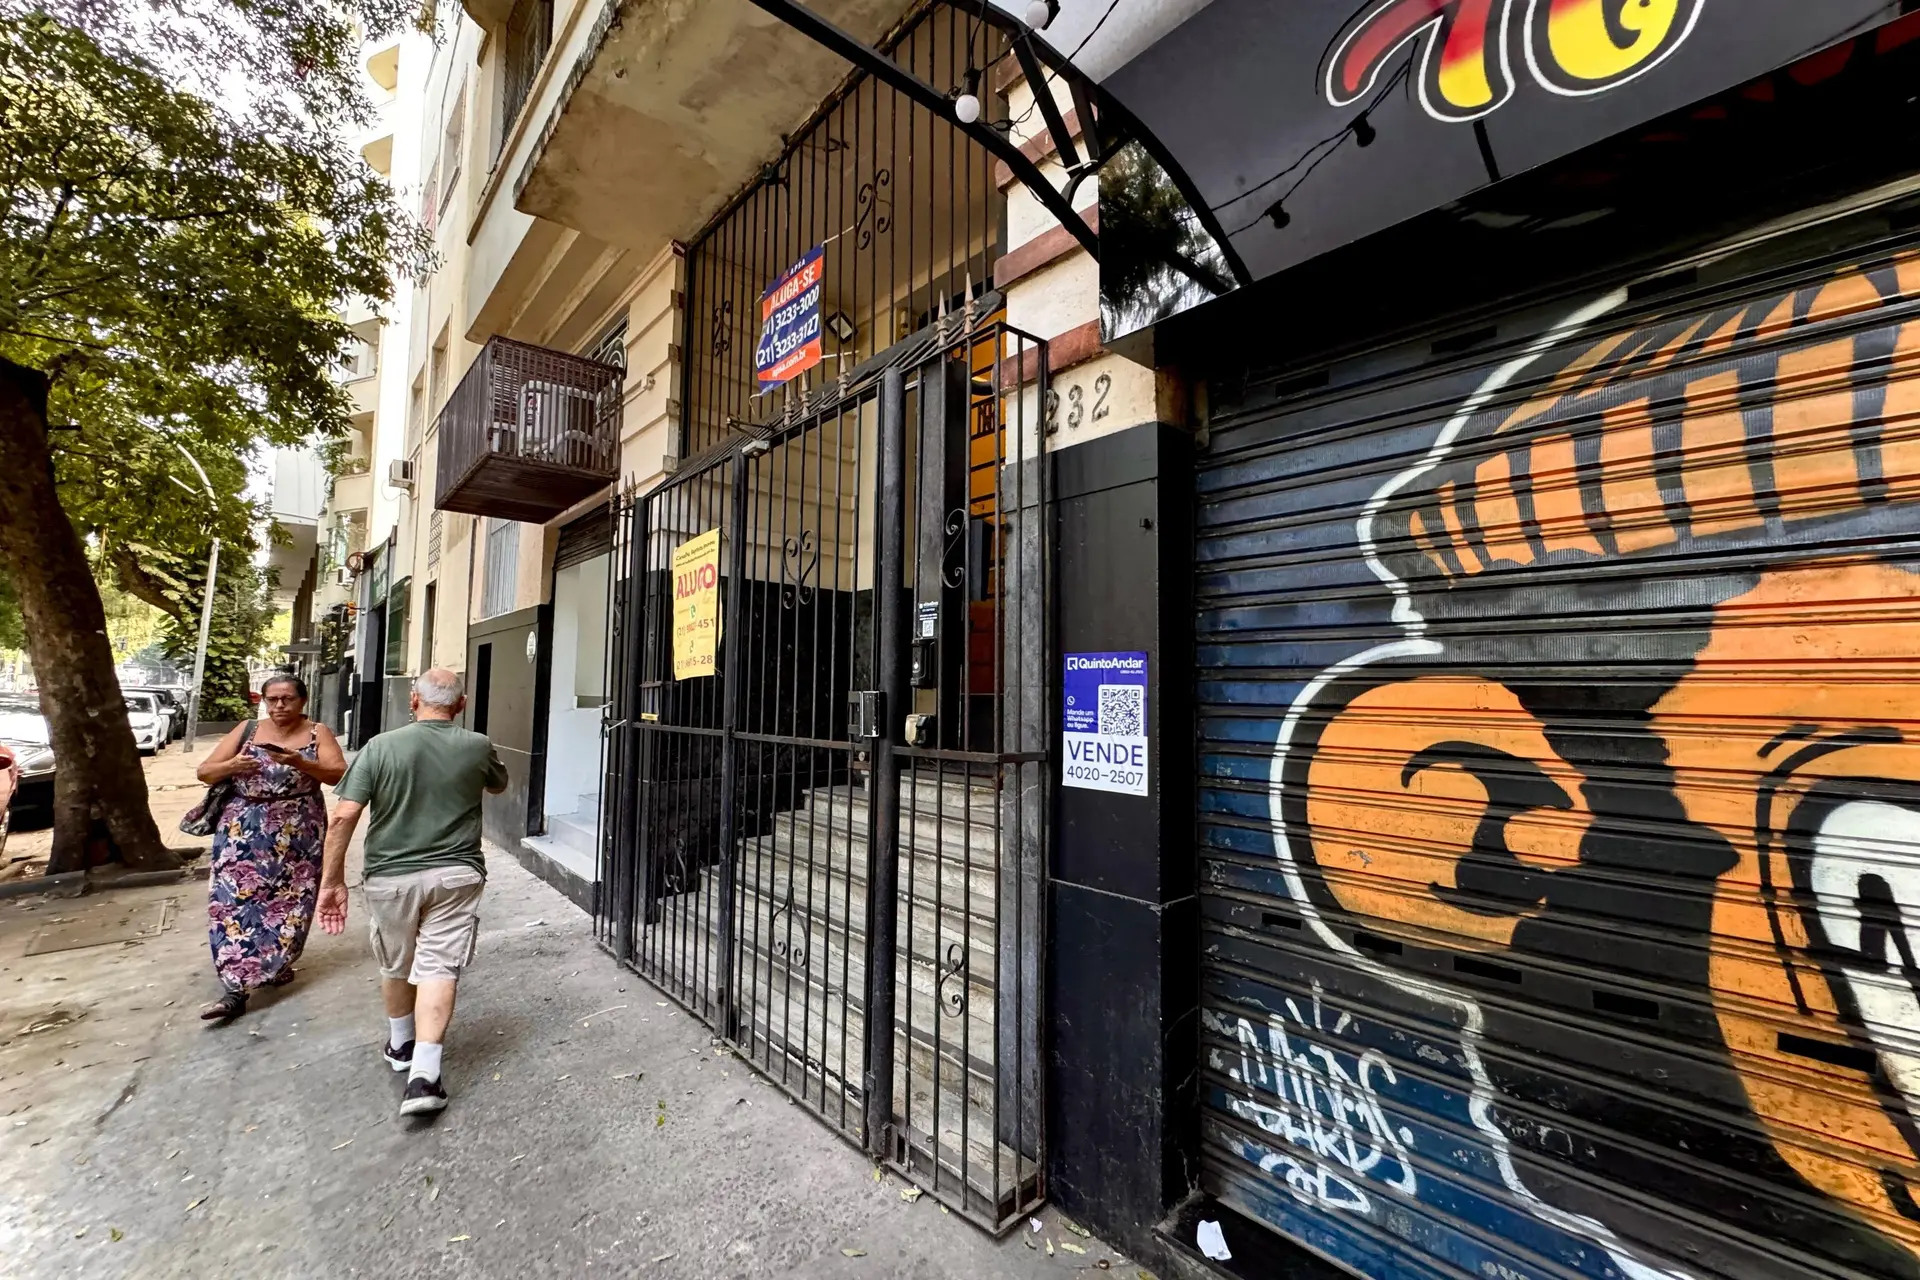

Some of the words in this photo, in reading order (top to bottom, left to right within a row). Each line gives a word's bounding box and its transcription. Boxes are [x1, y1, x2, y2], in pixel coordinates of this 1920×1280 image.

[770, 264, 816, 313] ALUGA-SE
[775, 284, 820, 331] 3233-3000
[755, 343, 775, 369] (21)
[775, 313, 819, 359] 3233-3127
[1043, 374, 1111, 437] 232
[1079, 657, 1144, 670] QuintoAndar
[1067, 765, 1144, 786] 4020-2507
[1068, 740, 1144, 767] VENDE
